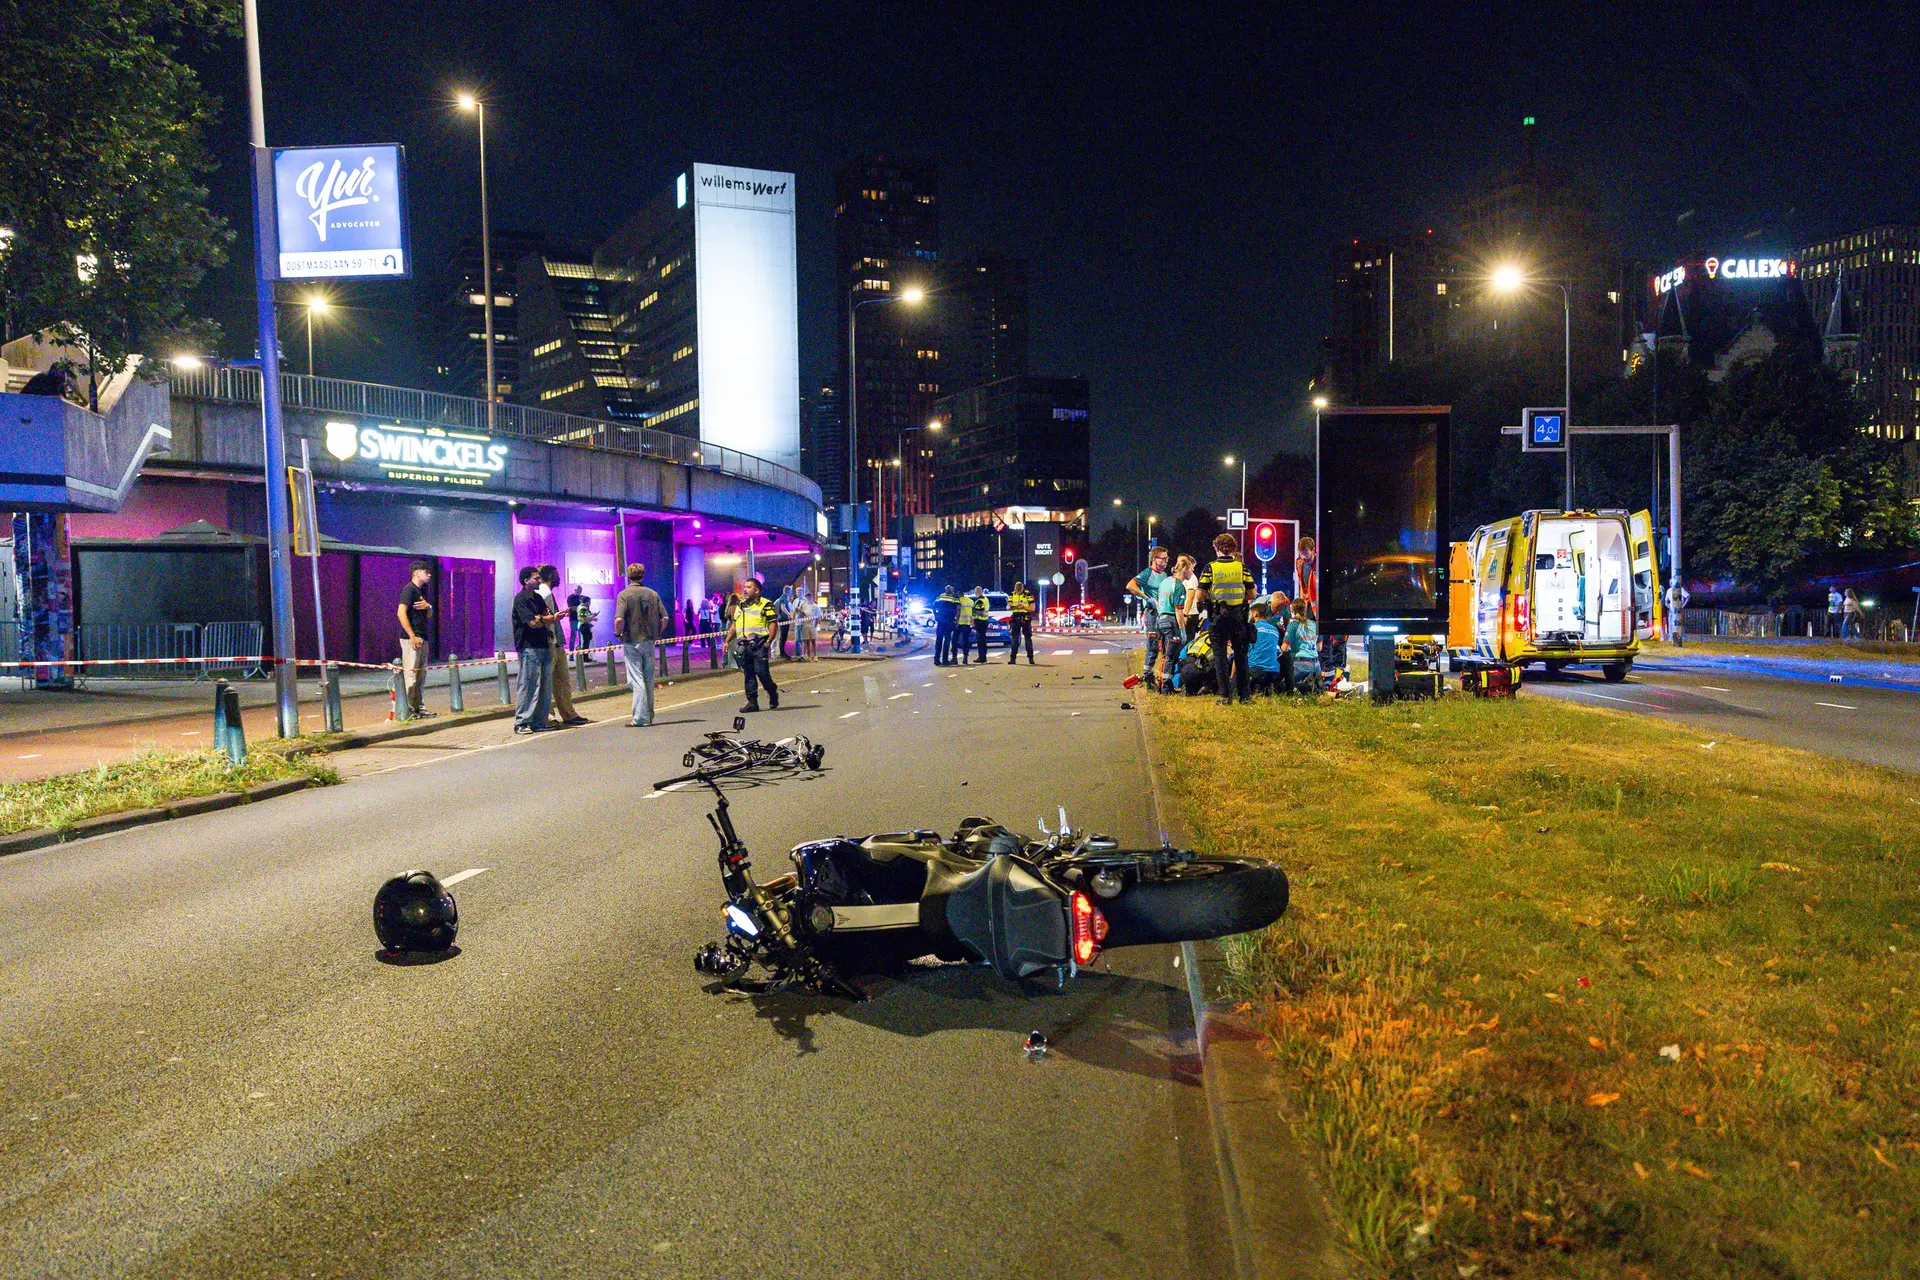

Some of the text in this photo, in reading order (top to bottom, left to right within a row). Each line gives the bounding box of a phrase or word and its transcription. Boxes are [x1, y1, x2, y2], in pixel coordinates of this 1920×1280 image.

[330, 220, 381, 229] ADVOCATEN
[1721, 258, 1782, 278] CALEX
[388, 471, 485, 486] SUPERIOR PILSNER
